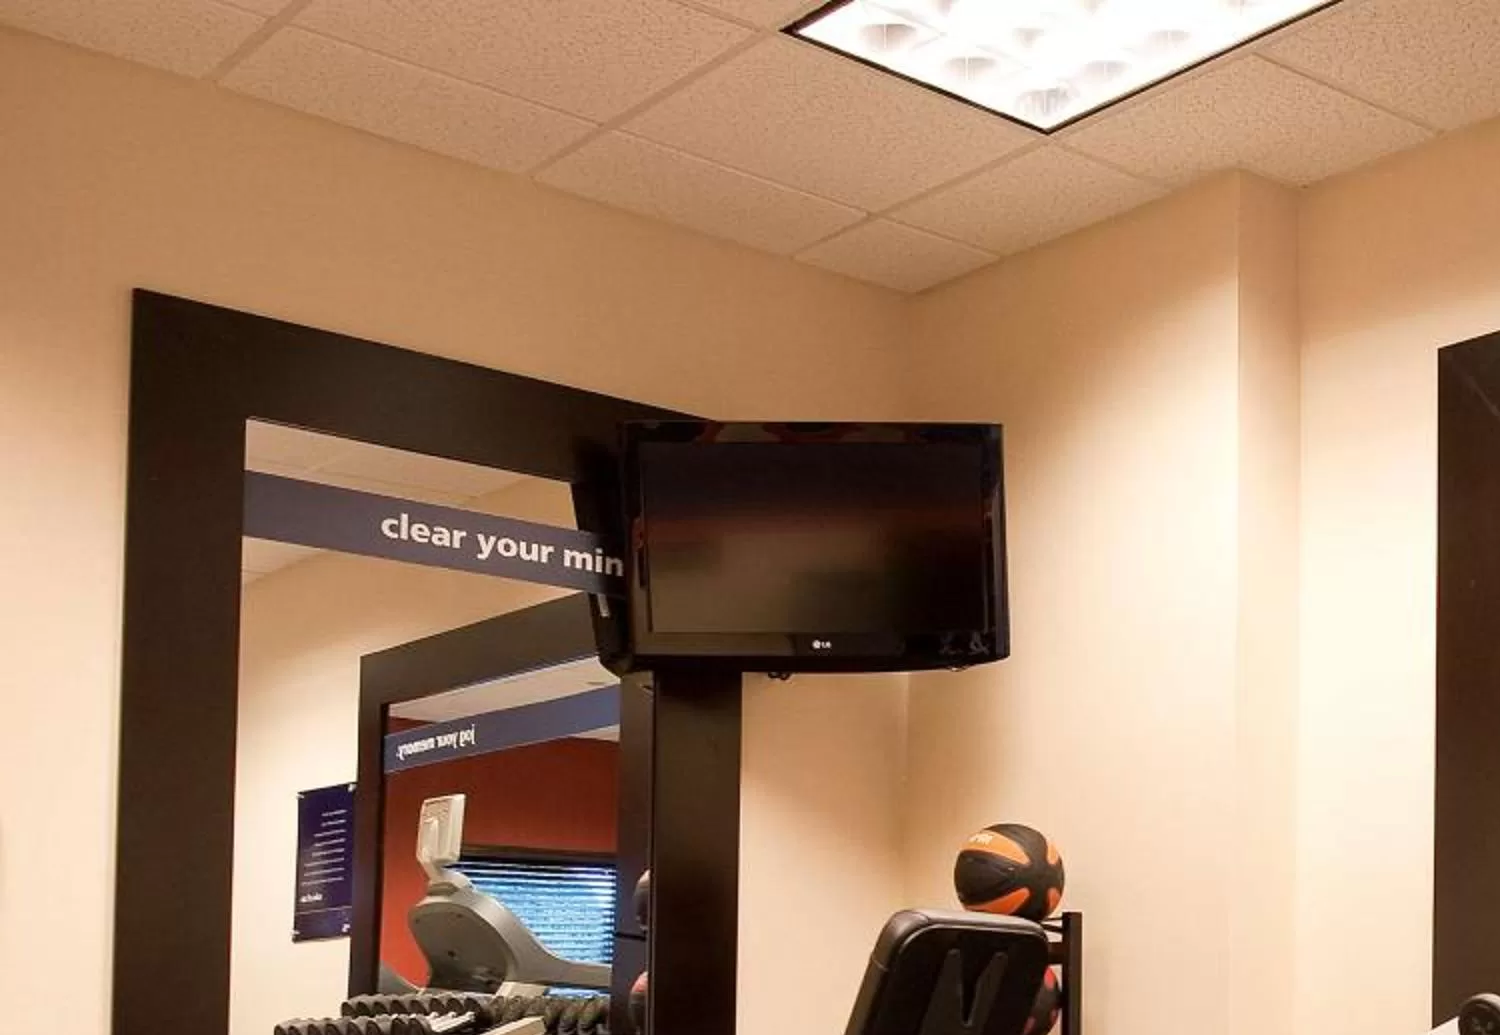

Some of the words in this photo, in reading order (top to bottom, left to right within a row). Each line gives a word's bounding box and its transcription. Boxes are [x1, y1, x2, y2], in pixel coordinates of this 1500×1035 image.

[380, 513, 467, 549] clear
[476, 532, 555, 564] your
[563, 548, 624, 577] min
